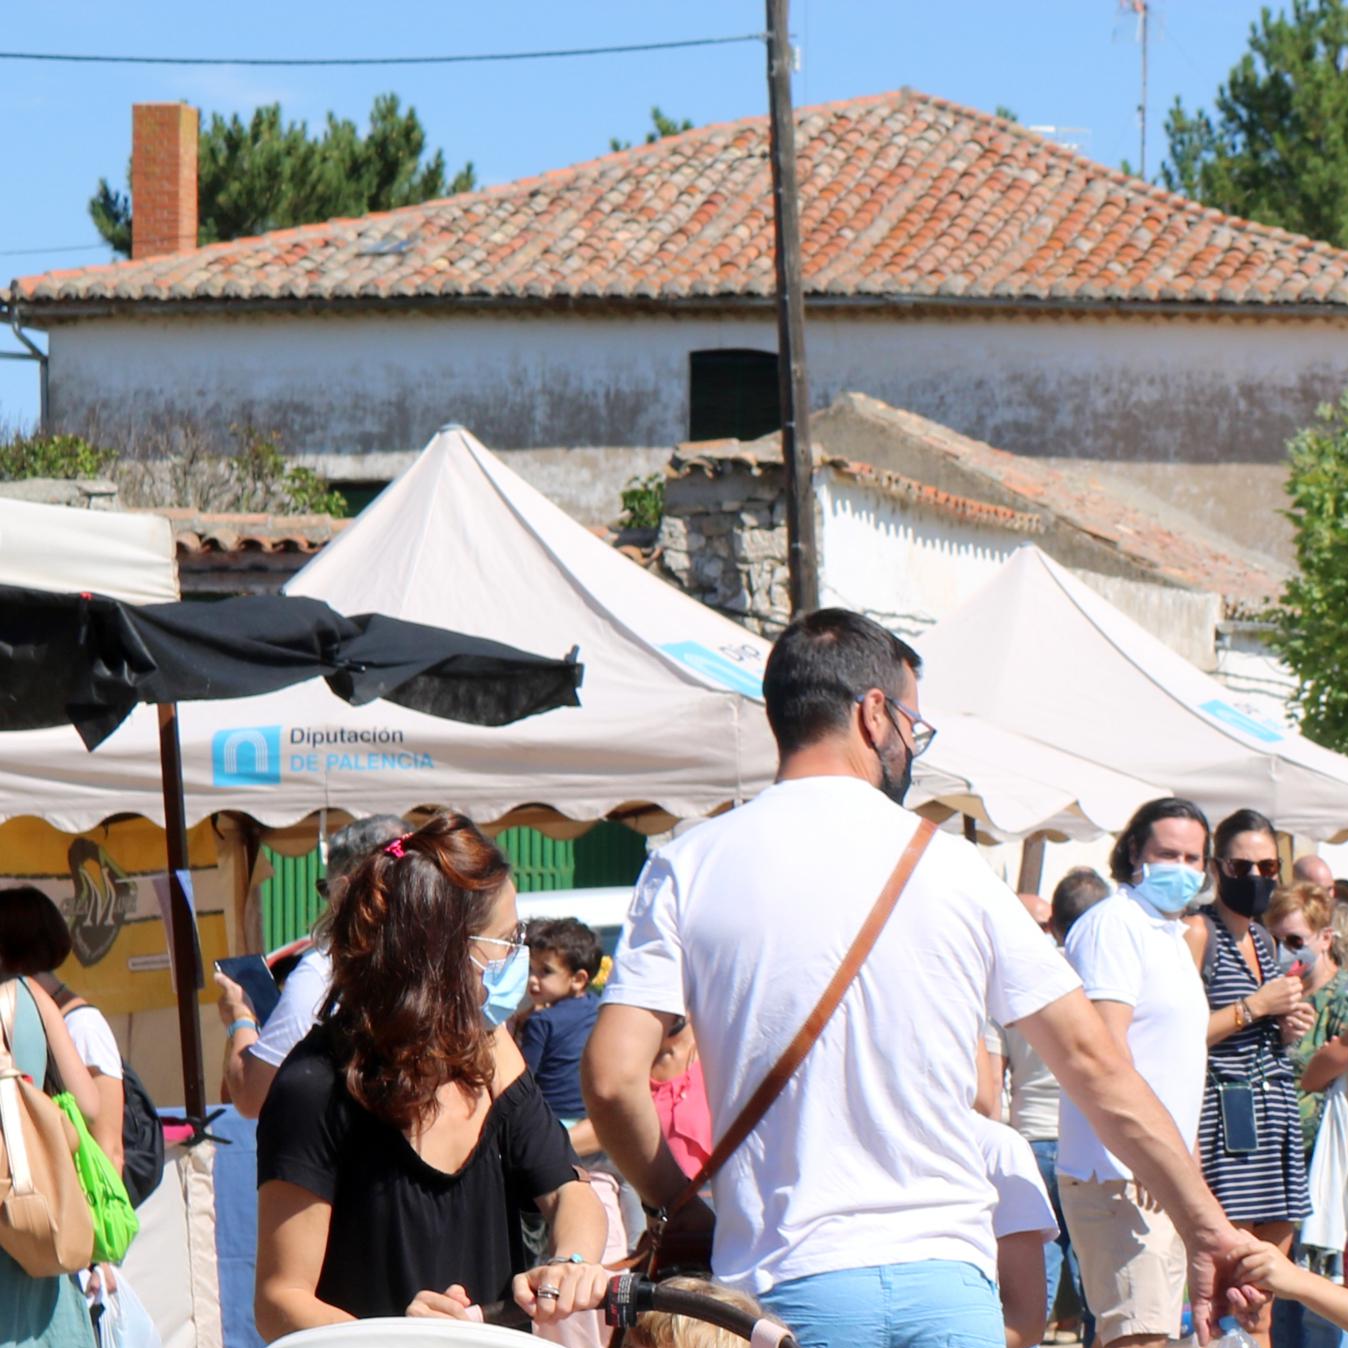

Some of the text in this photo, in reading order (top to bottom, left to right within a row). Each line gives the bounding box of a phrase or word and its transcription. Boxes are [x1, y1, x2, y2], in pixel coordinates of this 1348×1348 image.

[290, 726, 404, 749] Diputación
[290, 751, 435, 773] DE PALENCIA
